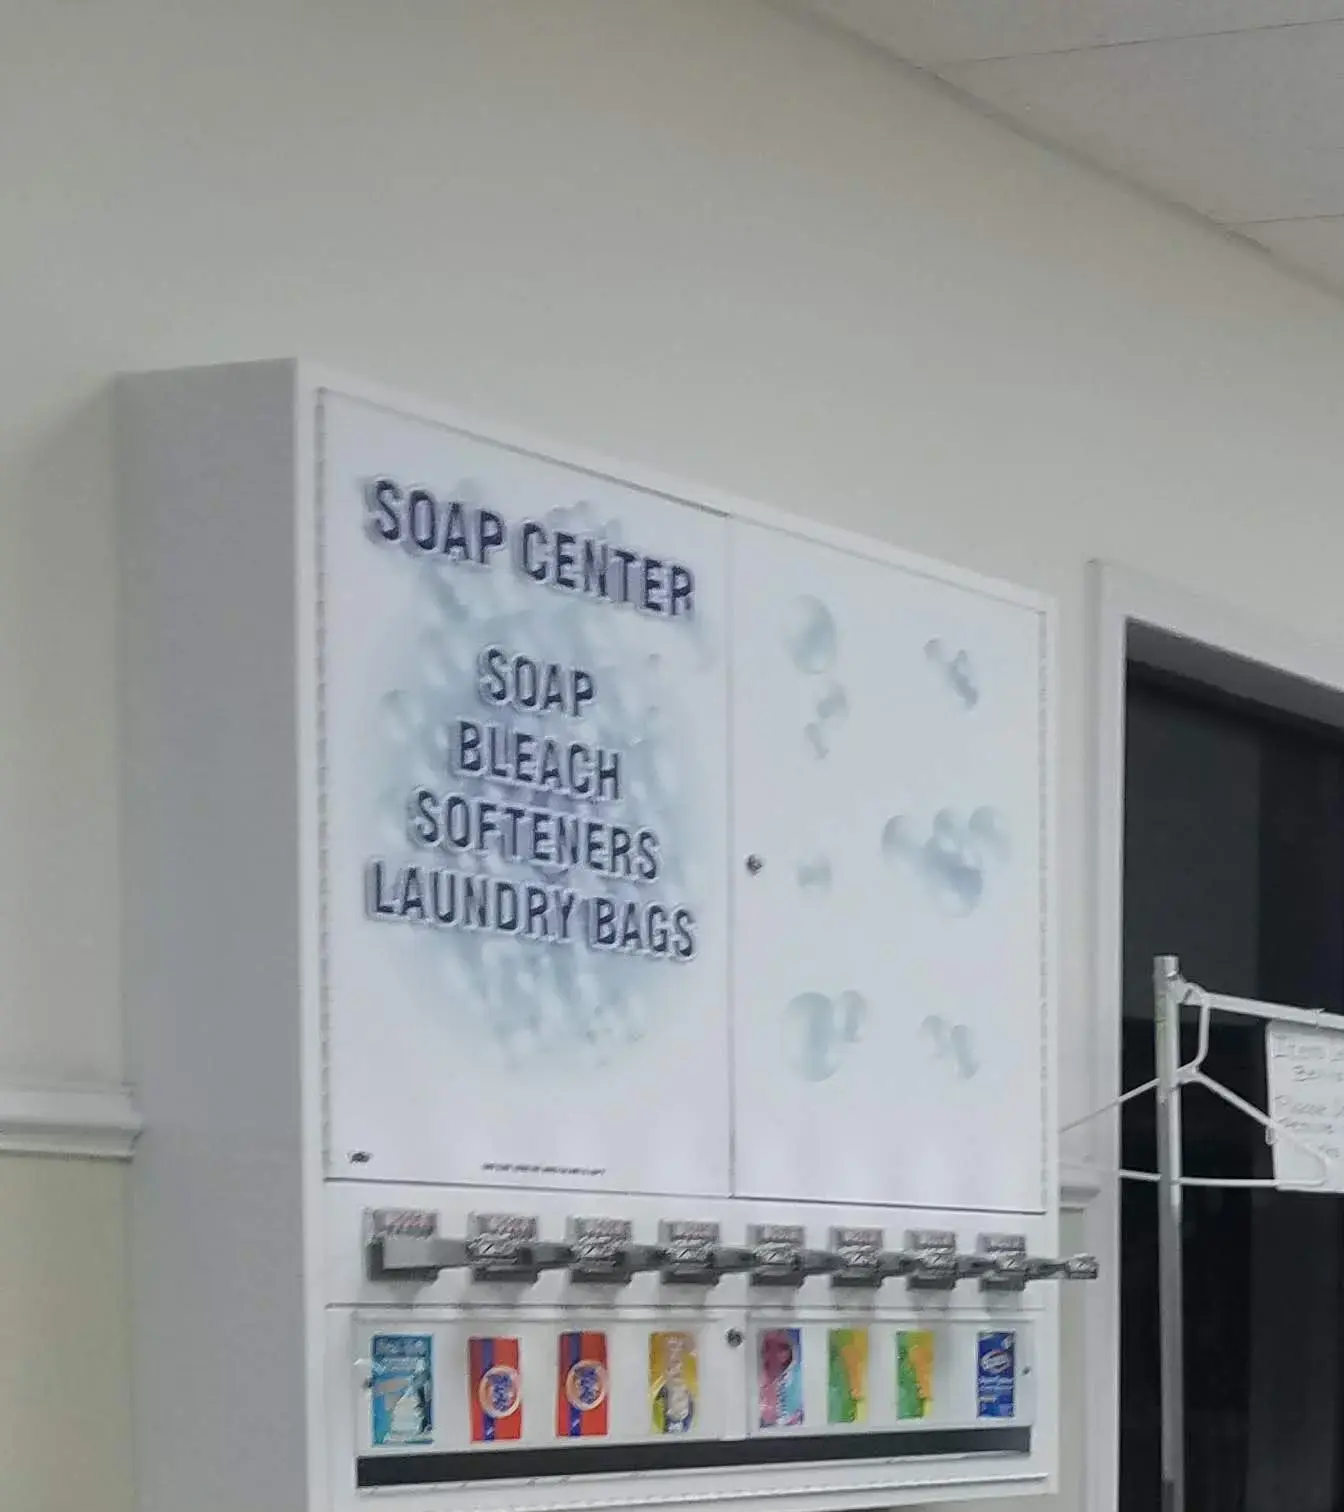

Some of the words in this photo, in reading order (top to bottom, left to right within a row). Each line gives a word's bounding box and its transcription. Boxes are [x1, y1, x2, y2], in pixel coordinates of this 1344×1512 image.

[370, 478, 505, 566] SOAP
[522, 520, 695, 616] CENTER
[482, 646, 594, 716] SOAP
[459, 720, 621, 801] BLEACH
[416, 788, 661, 881] SOFTENERS
[370, 861, 575, 938] LAUNDRY
[594, 898, 697, 960] BAGS
